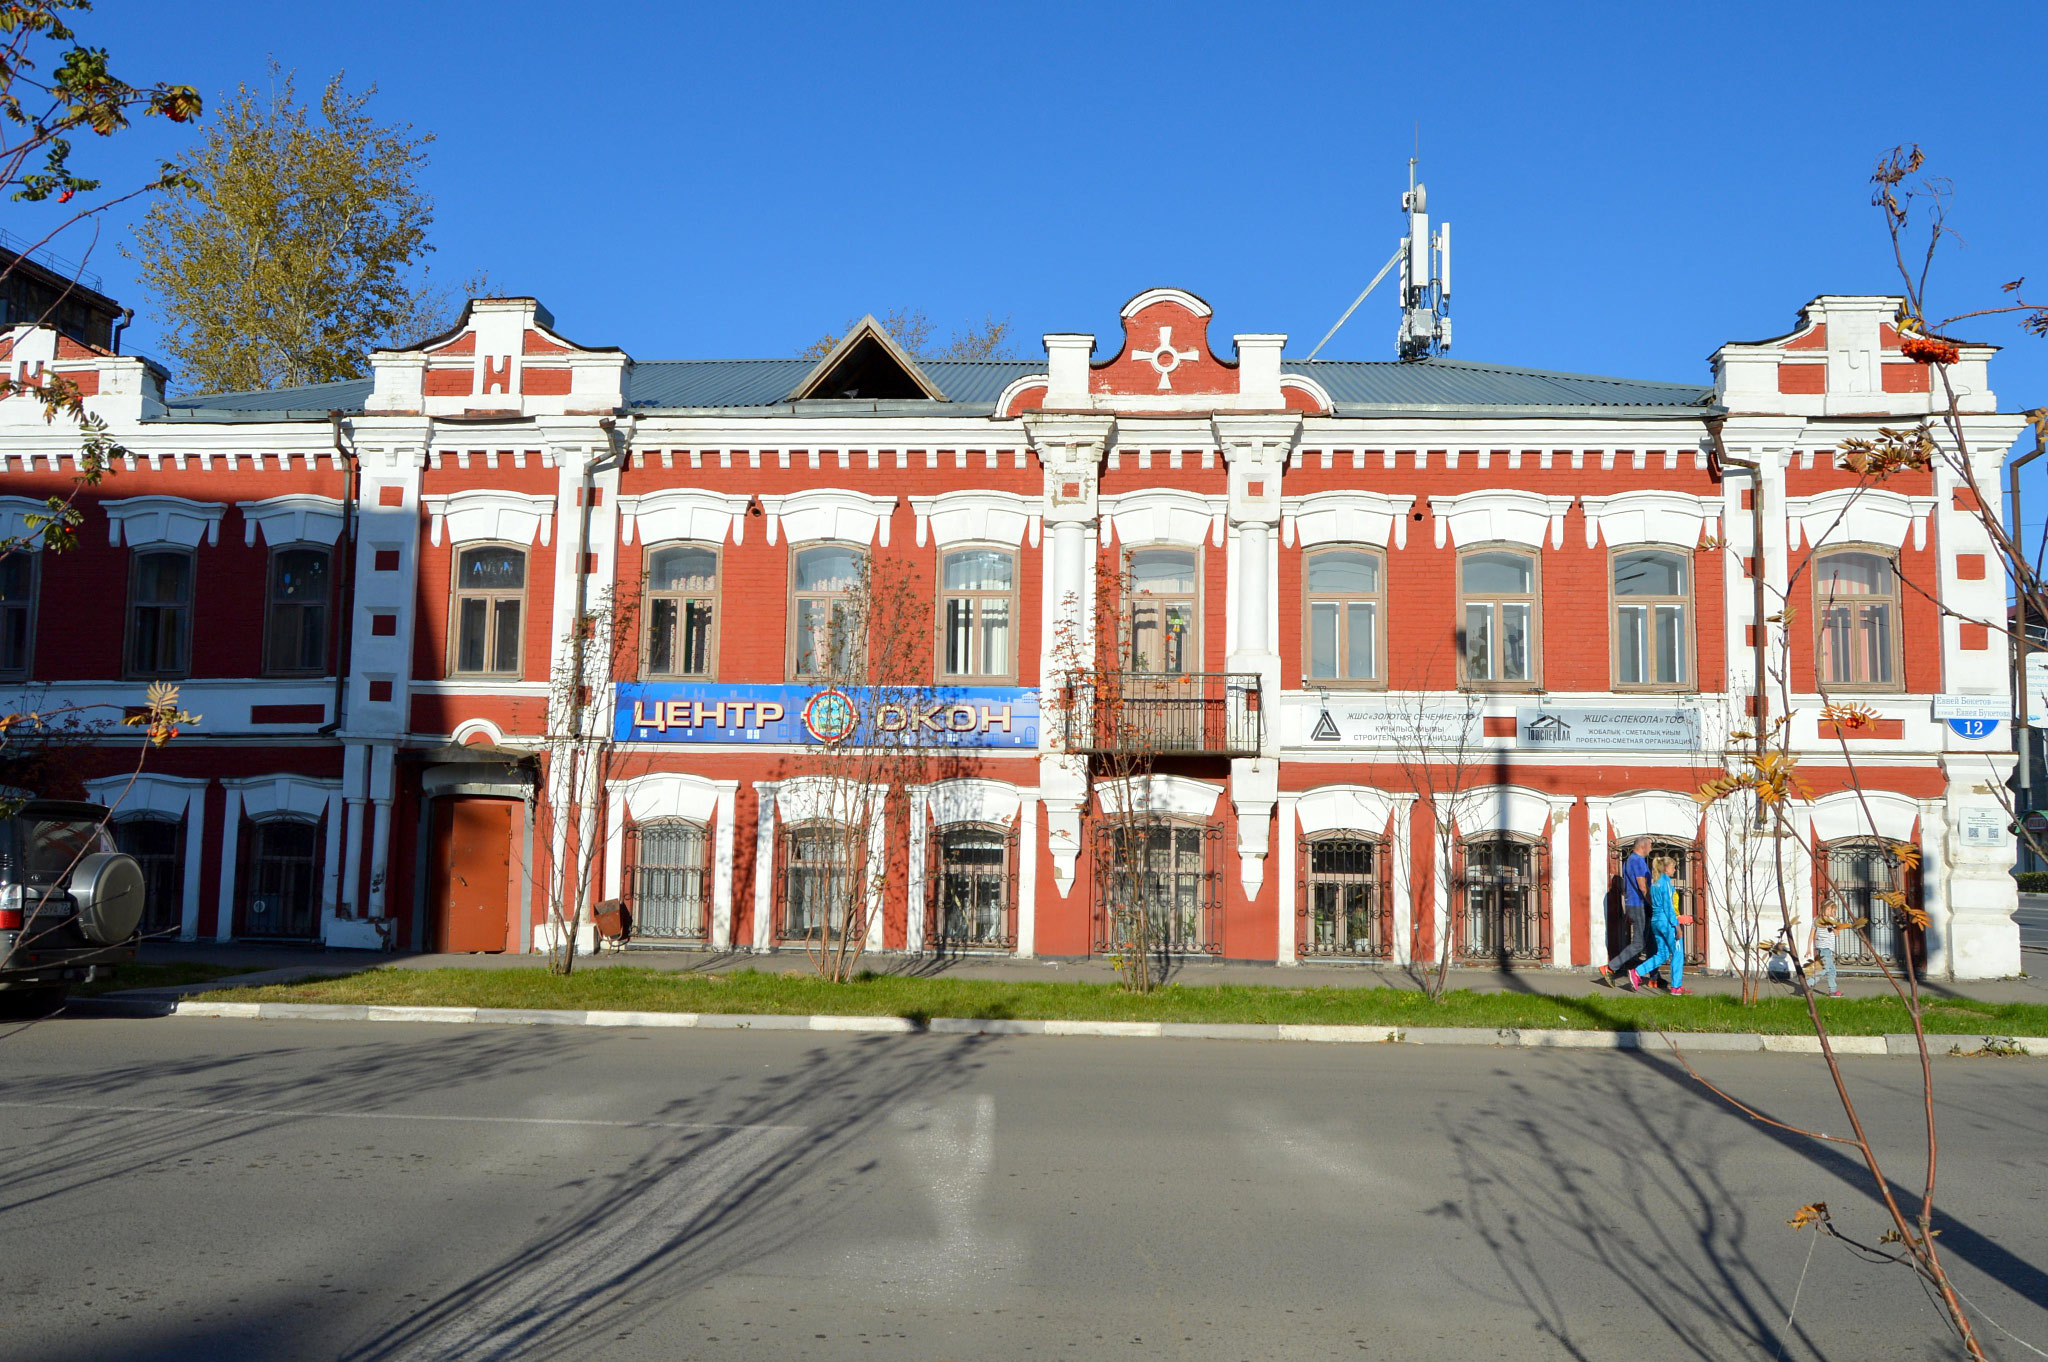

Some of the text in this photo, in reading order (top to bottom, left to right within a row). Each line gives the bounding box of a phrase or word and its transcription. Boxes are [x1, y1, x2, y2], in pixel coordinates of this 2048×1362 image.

[634, 701, 1012, 732] ЦЕНТР ОКОН
[1665, 715, 1685, 724] ТОО
[1964, 720, 1984, 735] 12
